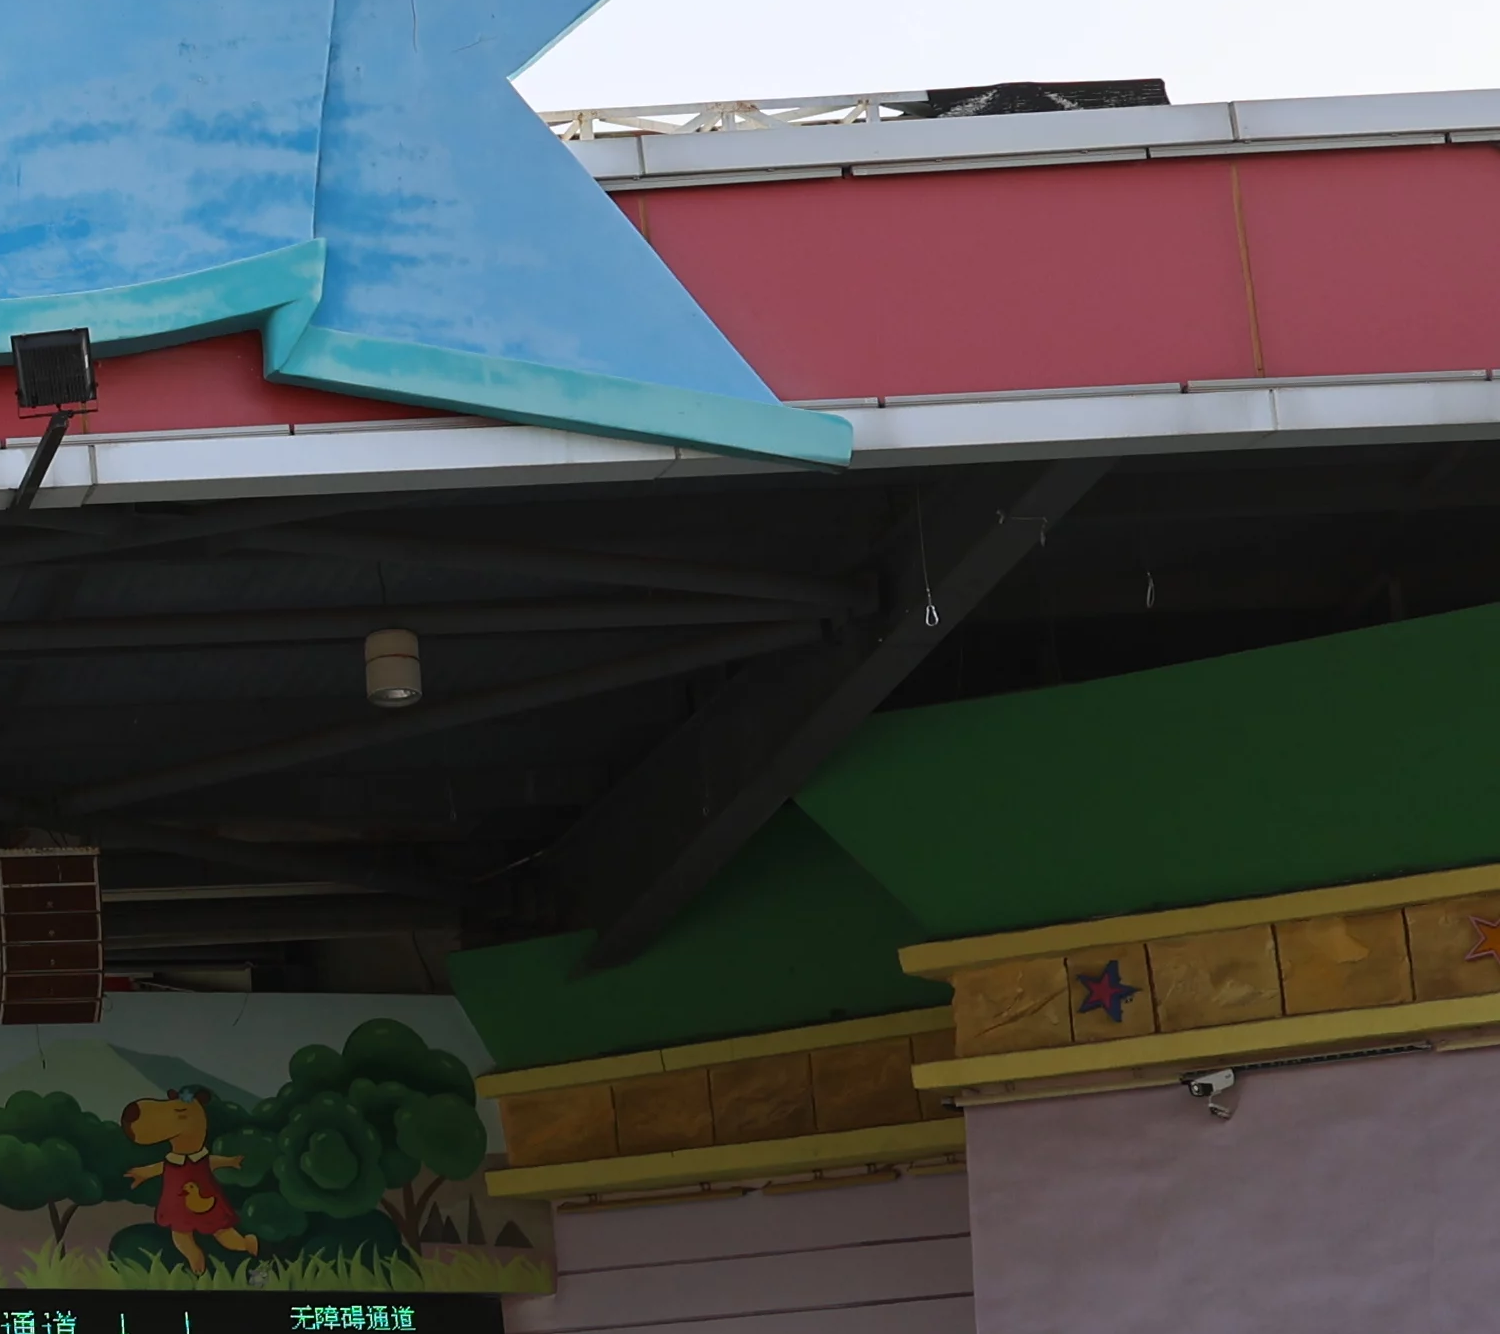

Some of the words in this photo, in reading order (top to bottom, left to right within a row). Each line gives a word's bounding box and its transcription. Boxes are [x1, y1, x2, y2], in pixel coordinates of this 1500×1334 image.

[290, 1305, 416, 1330] 无障碍通道
